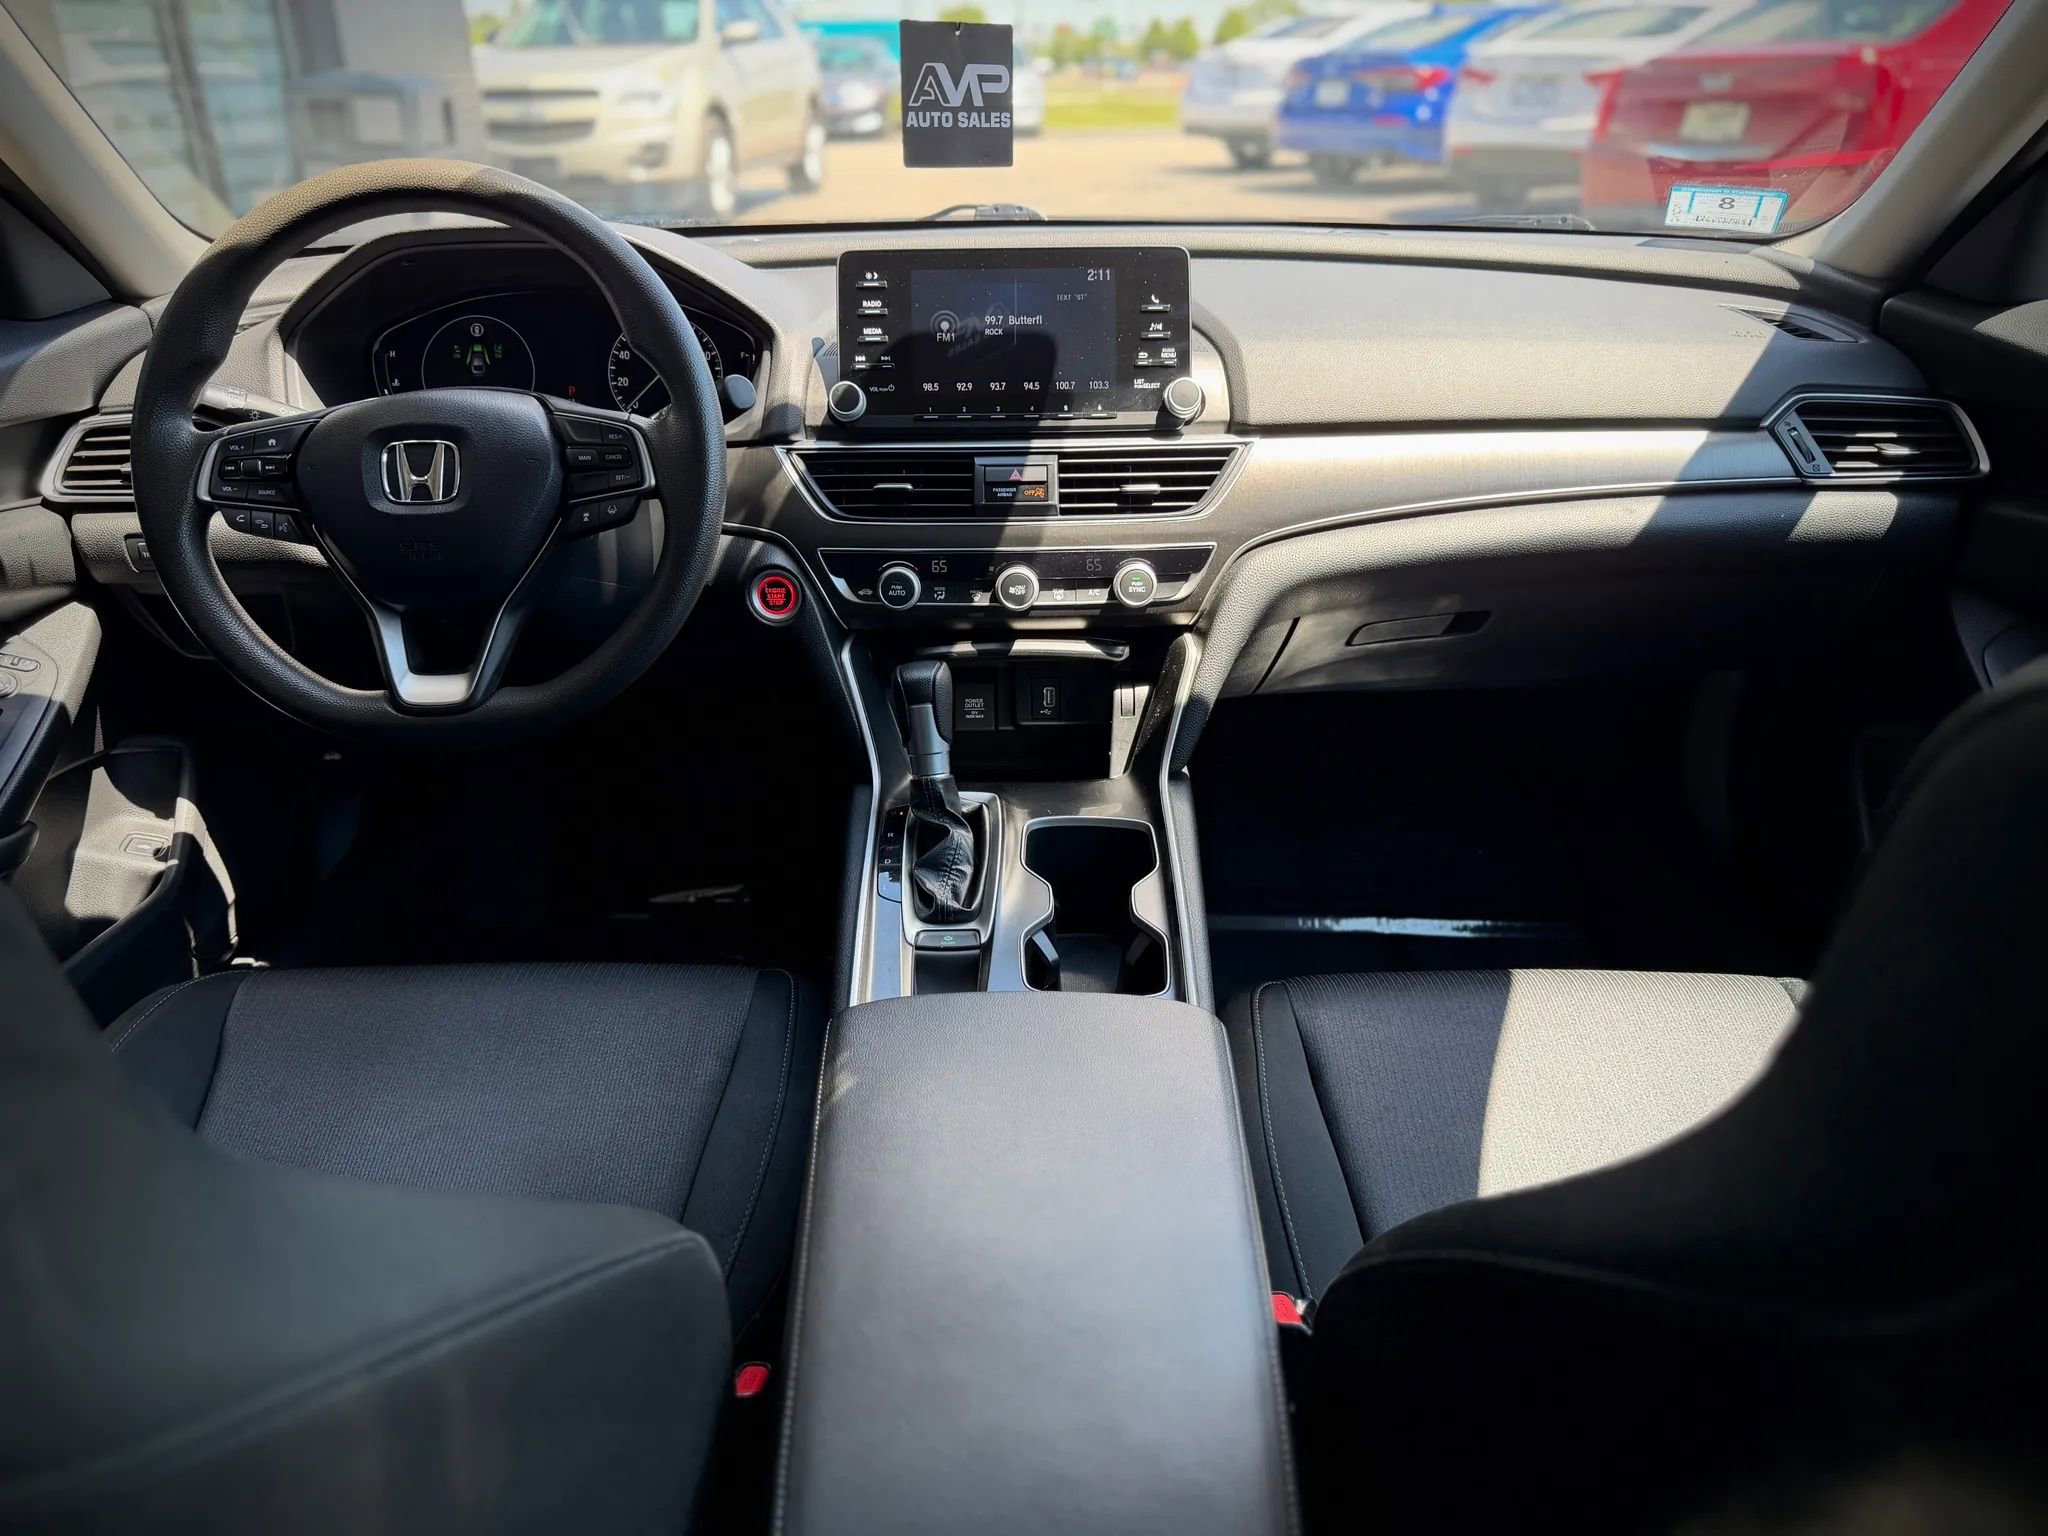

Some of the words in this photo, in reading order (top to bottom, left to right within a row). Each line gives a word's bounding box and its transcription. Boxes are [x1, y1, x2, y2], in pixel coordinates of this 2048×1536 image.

[906, 111, 953, 128] AUTO
[957, 112, 1011, 128] SALES
[1718, 197, 1735, 209] 8
[1087, 268, 1111, 281] 2:11
[984, 315, 1004, 325] 99.7
[1008, 315, 1042, 325] Butterfl
[936, 332, 955, 342] FM1
[618, 350, 630, 359] 40
[617, 377, 629, 387] 20
[922, 382, 940, 391] 98.5
[956, 382, 973, 391] 92.9
[989, 382, 1007, 391] 93.7
[1023, 381, 1040, 390] 94.5
[1055, 381, 1076, 390] 100.7
[1088, 380, 1110, 389] 103.3
[931, 560, 948, 573] 65
[1086, 558, 1102, 571] 65
[1088, 588, 1101, 596] A/C
